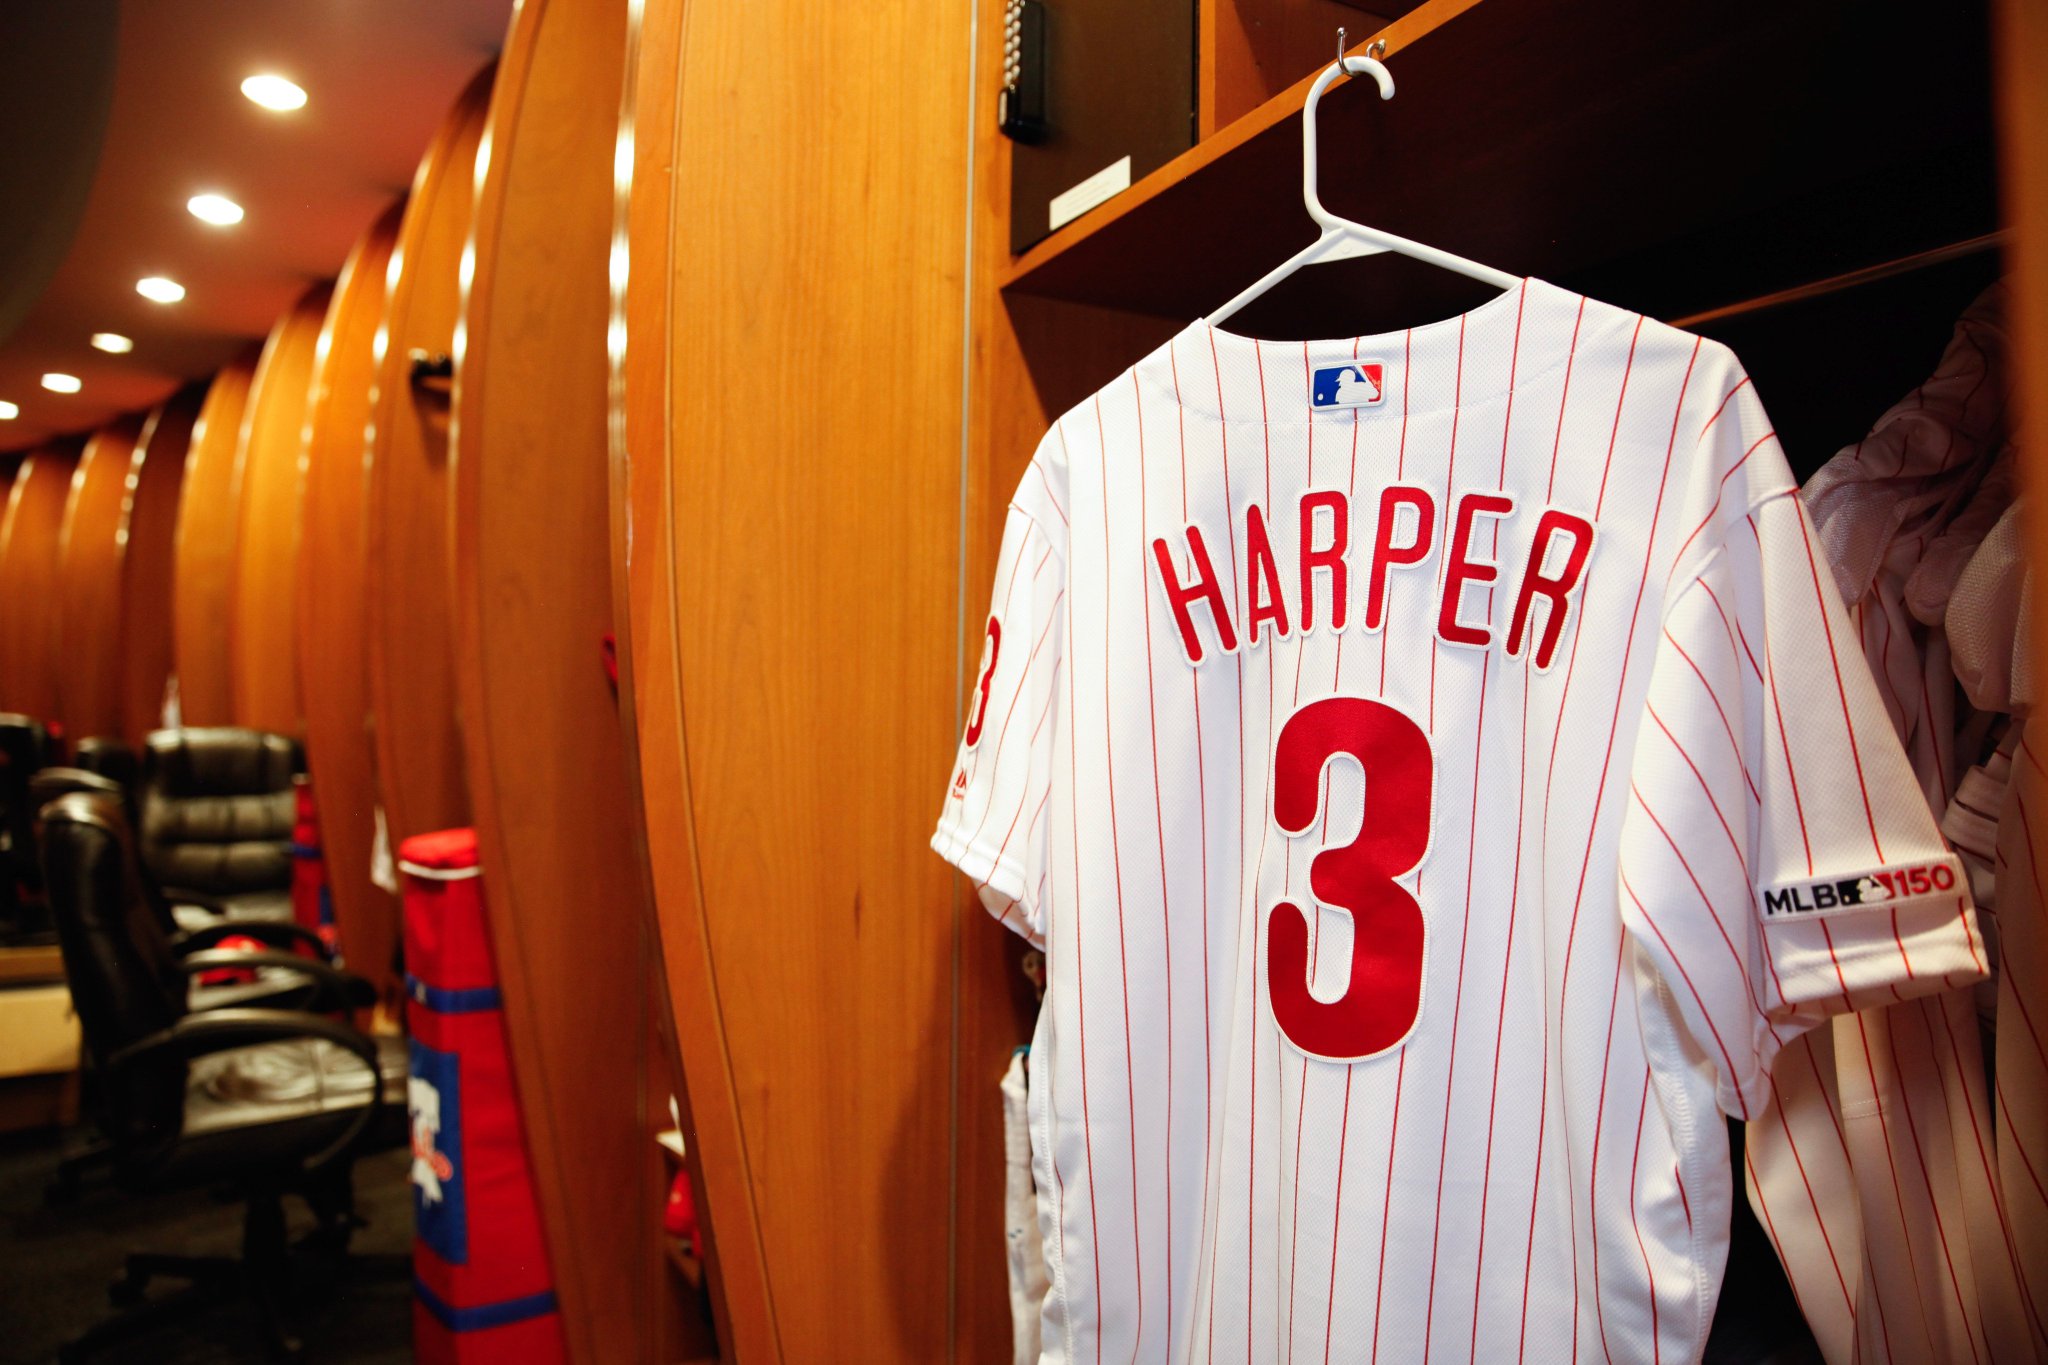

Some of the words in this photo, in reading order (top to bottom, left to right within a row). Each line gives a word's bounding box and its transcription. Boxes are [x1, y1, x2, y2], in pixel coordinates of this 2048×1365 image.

[1152, 487, 1596, 669] HARPER
[1267, 697, 1433, 1058] 3
[1763, 884, 1838, 915] MLB
[1893, 864, 1956, 897] 150
